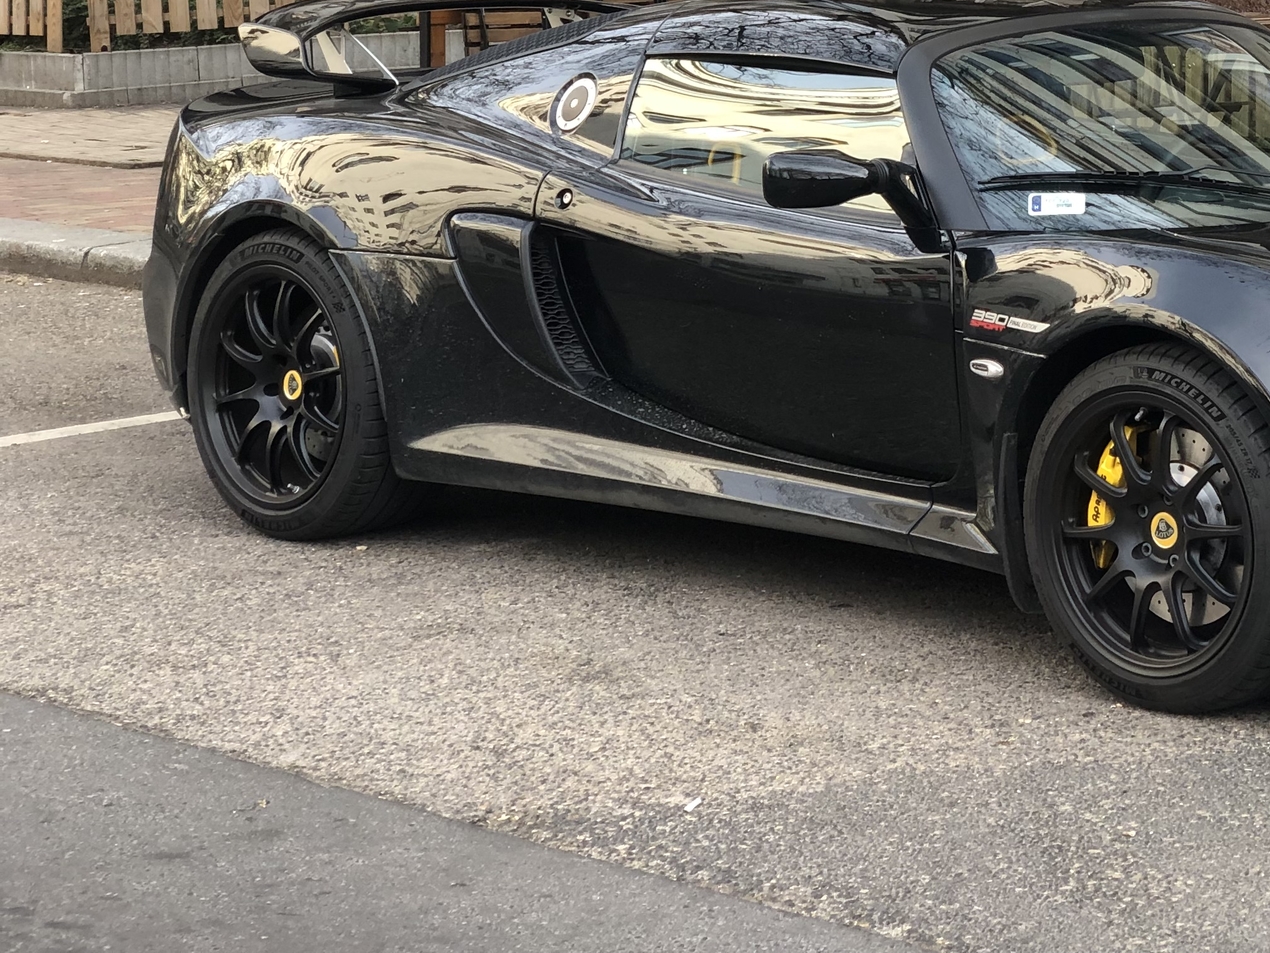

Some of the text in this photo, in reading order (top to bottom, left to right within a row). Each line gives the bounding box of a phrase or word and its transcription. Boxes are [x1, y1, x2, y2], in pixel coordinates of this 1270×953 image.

[244, 243, 300, 262] MICHELIN
[971, 308, 1009, 327] 390
[1151, 370, 1222, 420] MICHELIN
[1155, 528, 1175, 539] LOTUS
